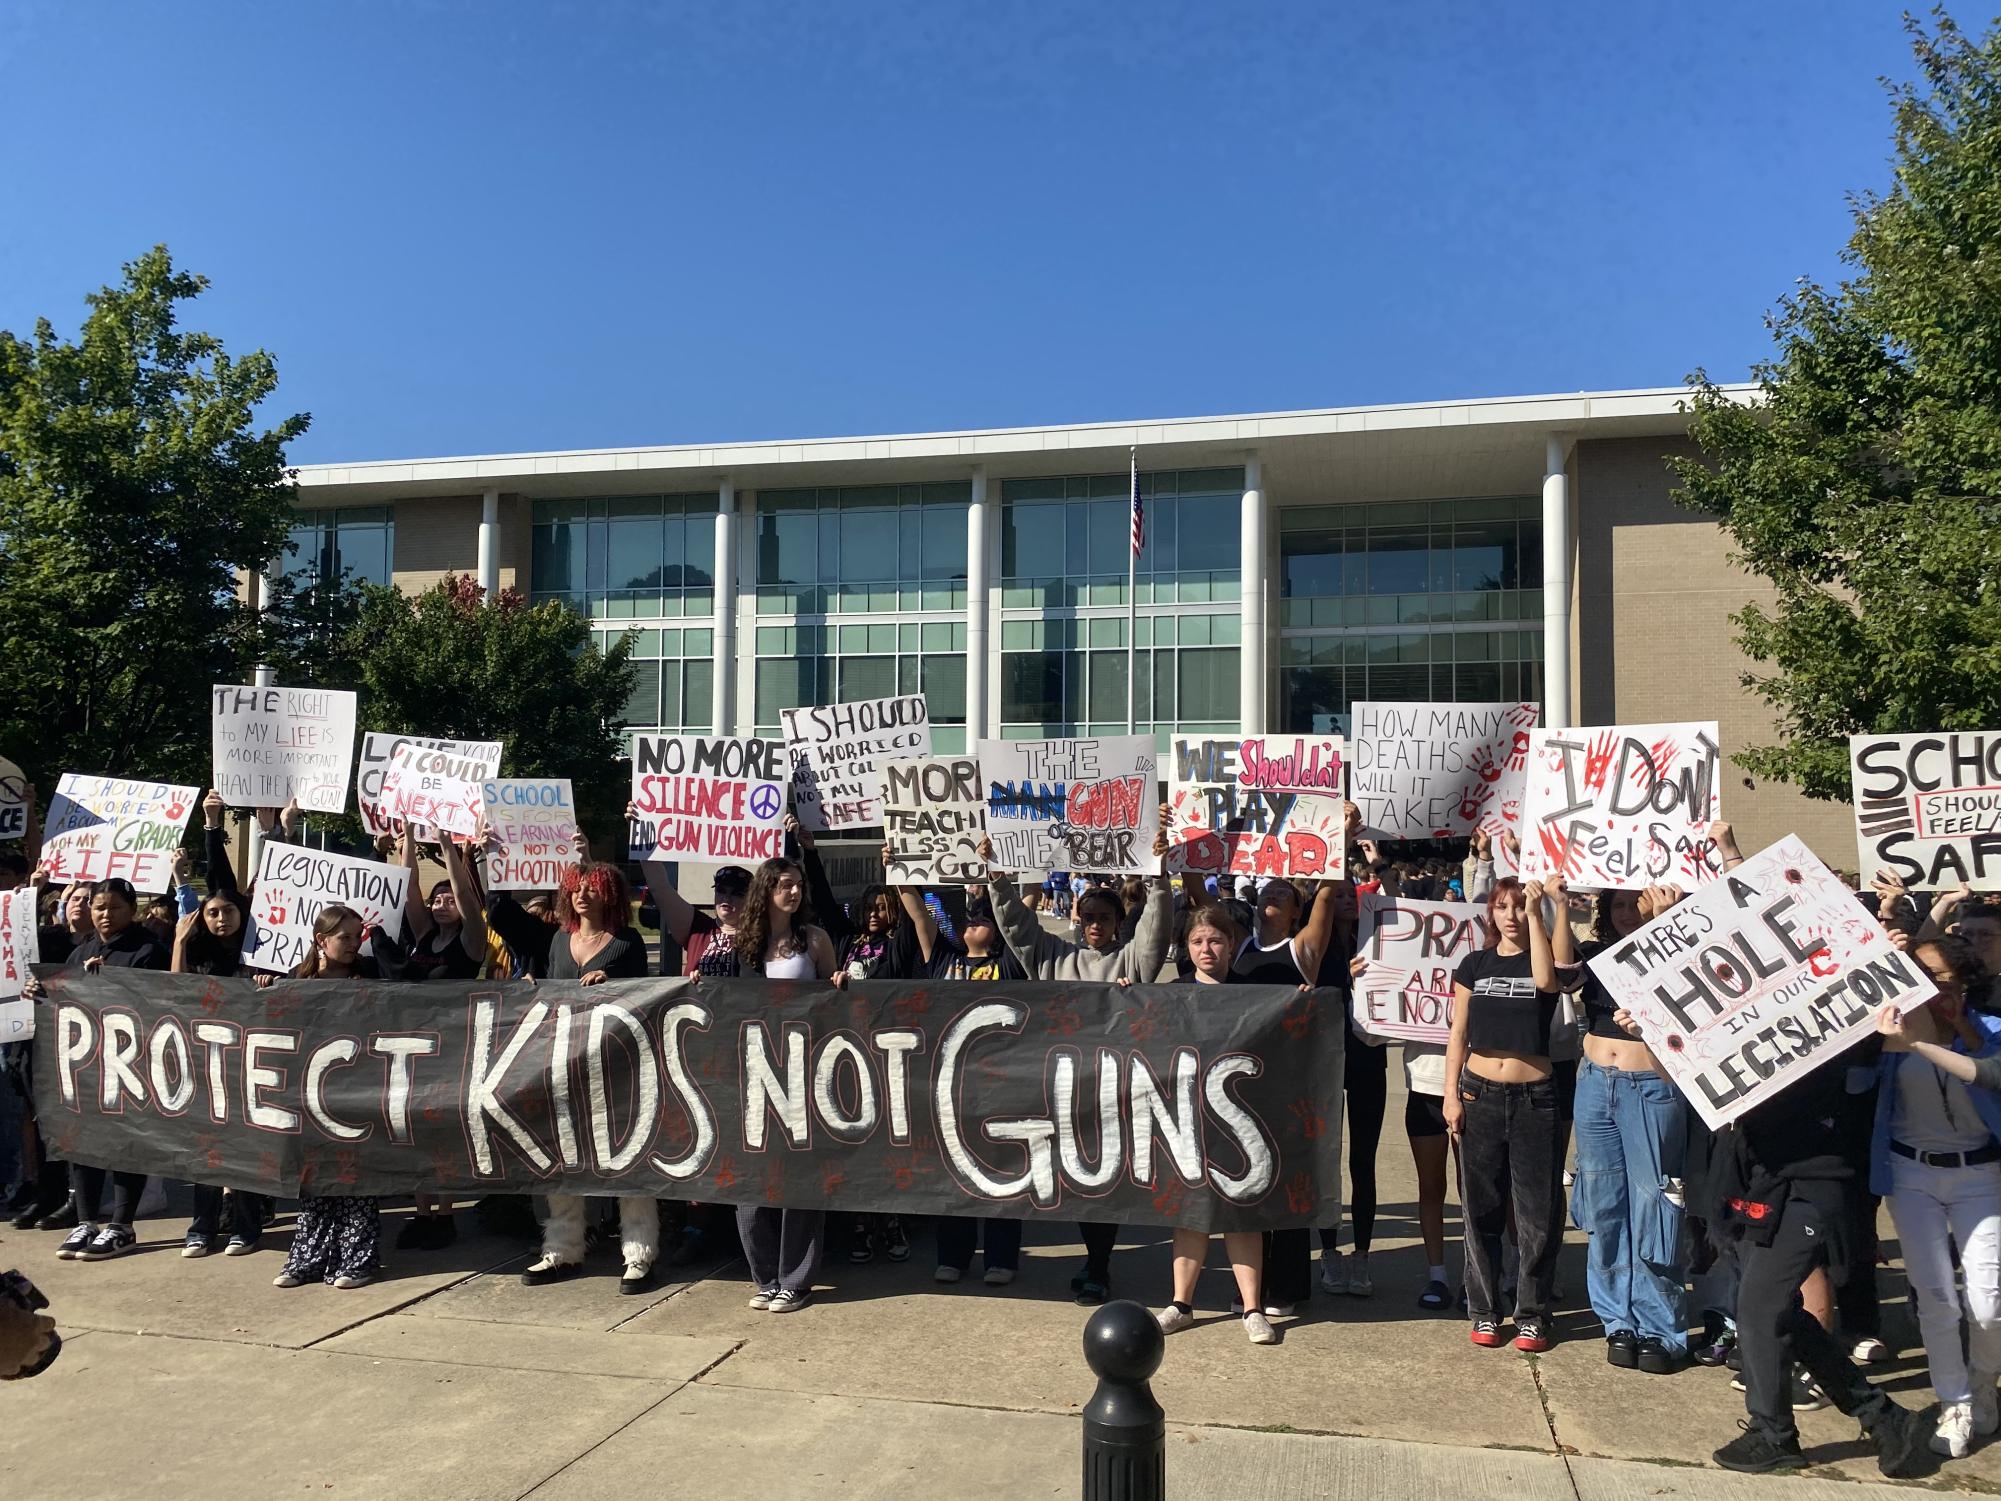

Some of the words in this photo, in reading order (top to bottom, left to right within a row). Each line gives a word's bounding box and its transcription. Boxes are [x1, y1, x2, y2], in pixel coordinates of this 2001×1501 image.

[214, 687, 281, 715] THE
[287, 692, 333, 719] RIGHT
[782, 709, 808, 744] I
[810, 698, 926, 743] SHOULD
[244, 722, 268, 744] MY
[275, 725, 319, 746] LIFE
[322, 728, 334, 743] IS
[1361, 708, 1418, 738] HOW
[1429, 710, 1505, 739] MANY
[226, 748, 273, 764] MORE
[280, 751, 339, 768] IMPORTANT
[402, 752, 413, 769] I
[415, 752, 488, 783] COULD
[638, 738, 685, 774] NO
[692, 738, 785, 781] MORE
[789, 747, 812, 770] BE
[817, 732, 922, 764] WORRIED
[1016, 740, 1100, 780] THE
[1175, 739, 1240, 783] WE
[1357, 739, 1463, 773] DEATHS
[66, 776, 81, 795] I
[89, 779, 169, 800] SHOULD
[216, 773, 252, 796] THAN
[259, 774, 282, 796] THE
[421, 777, 443, 790] BE
[484, 783, 569, 806] SCHOOL
[636, 775, 747, 820] SILENCE
[830, 782, 864, 798] MY
[1355, 772, 1397, 793] WILL
[1412, 777, 1431, 797] IT
[1541, 739, 1593, 825] I
[394, 788, 464, 826] NEXT
[490, 808, 514, 821] IS
[523, 809, 572, 823] FOR
[1066, 773, 1147, 829] GUN
[1202, 784, 1297, 836] PLAY
[1357, 792, 1463, 829] TAKE?
[76, 833, 101, 849] MY
[523, 843, 550, 855] NOT
[631, 820, 656, 851] END
[657, 818, 702, 853] GUN
[707, 823, 782, 859] VIOLENCE
[992, 829, 1055, 869] THE
[1061, 828, 1144, 870] BEAR
[1180, 826, 1328, 876] DEAD
[52, 850, 159, 883] LIFE
[491, 859, 577, 884] SHOOTIN
[1613, 905, 1713, 977] THERE'S
[1727, 877, 1761, 909] A
[1653, 895, 1828, 1034] HOLE
[1723, 1005, 1761, 1035] IN
[1773, 971, 1818, 1006] OUR
[56, 1003, 438, 1143] PROTECT
[468, 1000, 715, 1177] KIDS
[744, 1022, 921, 1148] NOT
[936, 1002, 1273, 1201] GUNS
